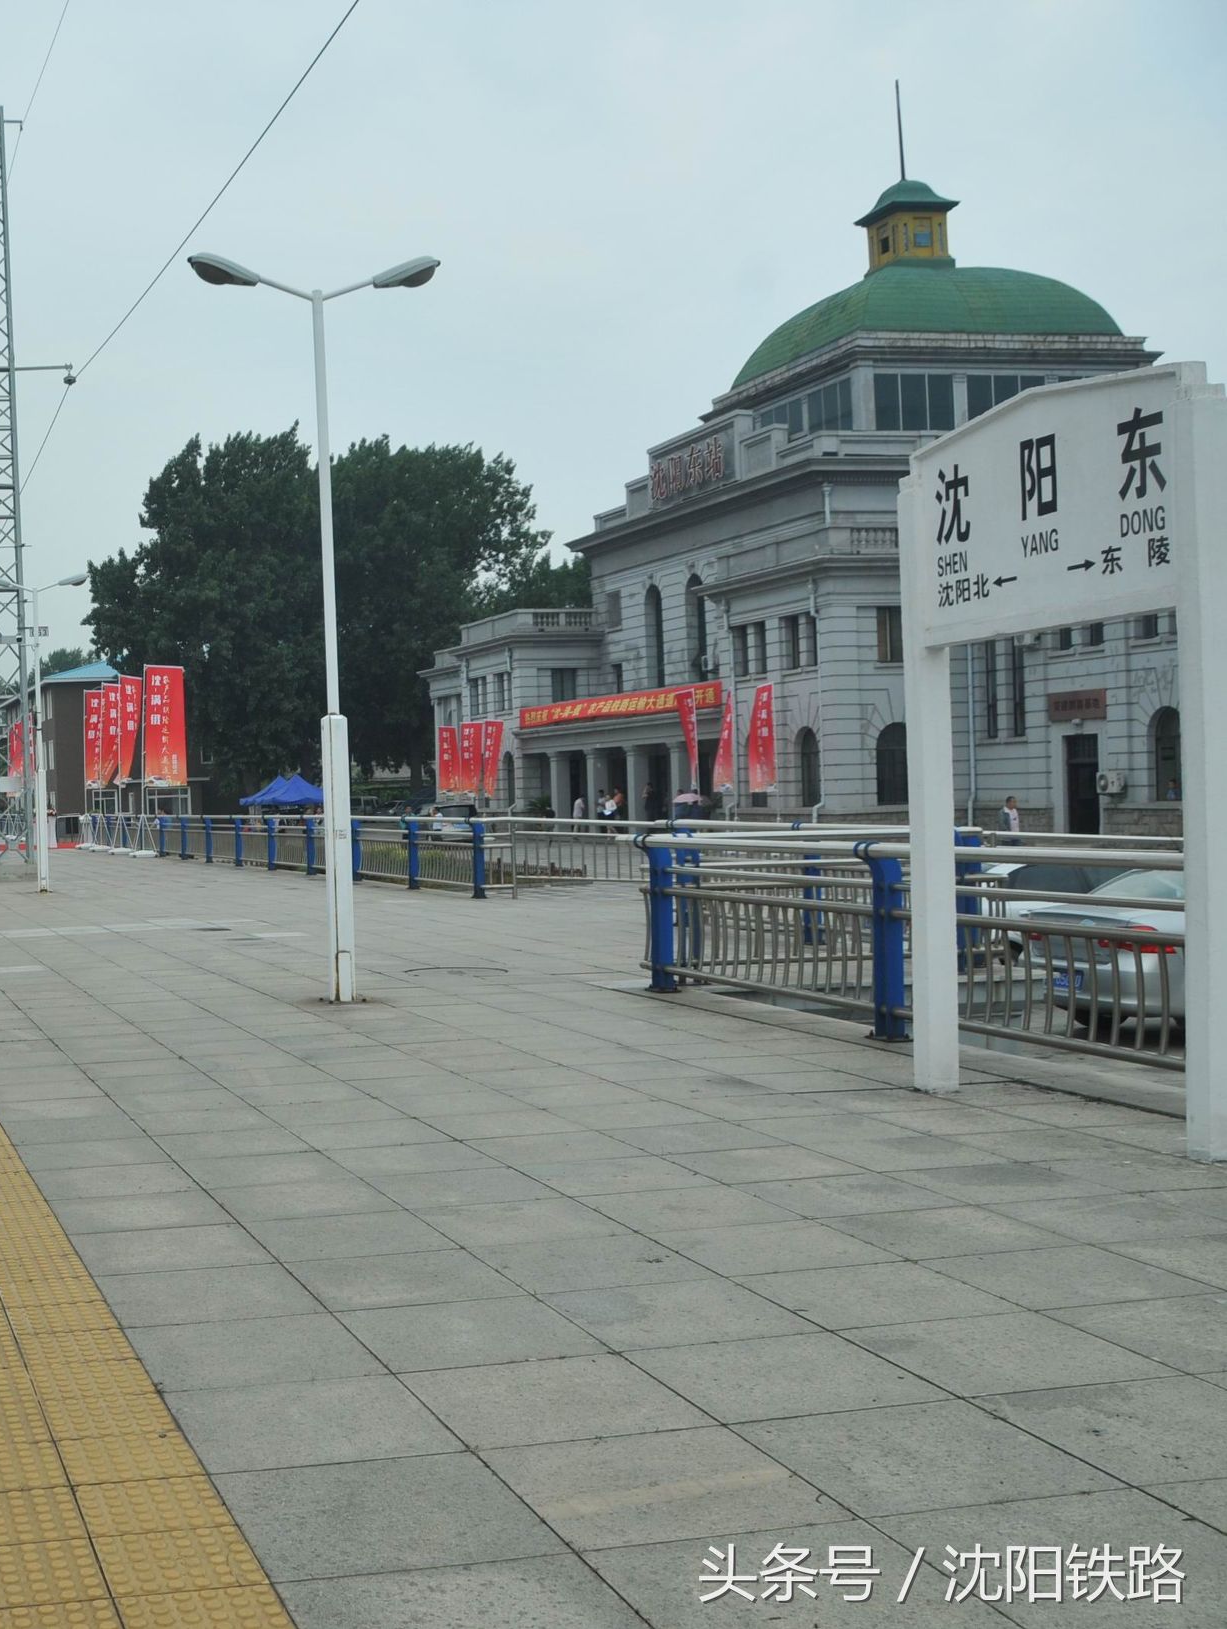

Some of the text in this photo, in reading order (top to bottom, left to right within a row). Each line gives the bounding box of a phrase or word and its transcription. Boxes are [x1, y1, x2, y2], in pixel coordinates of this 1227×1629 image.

[935, 407, 1167, 545] 沈阳东
[937, 506, 1165, 577] SHEN YANG DONG
[1101, 537, 1170, 575] 东陵
[938, 574, 990, 608] 沈阳北
